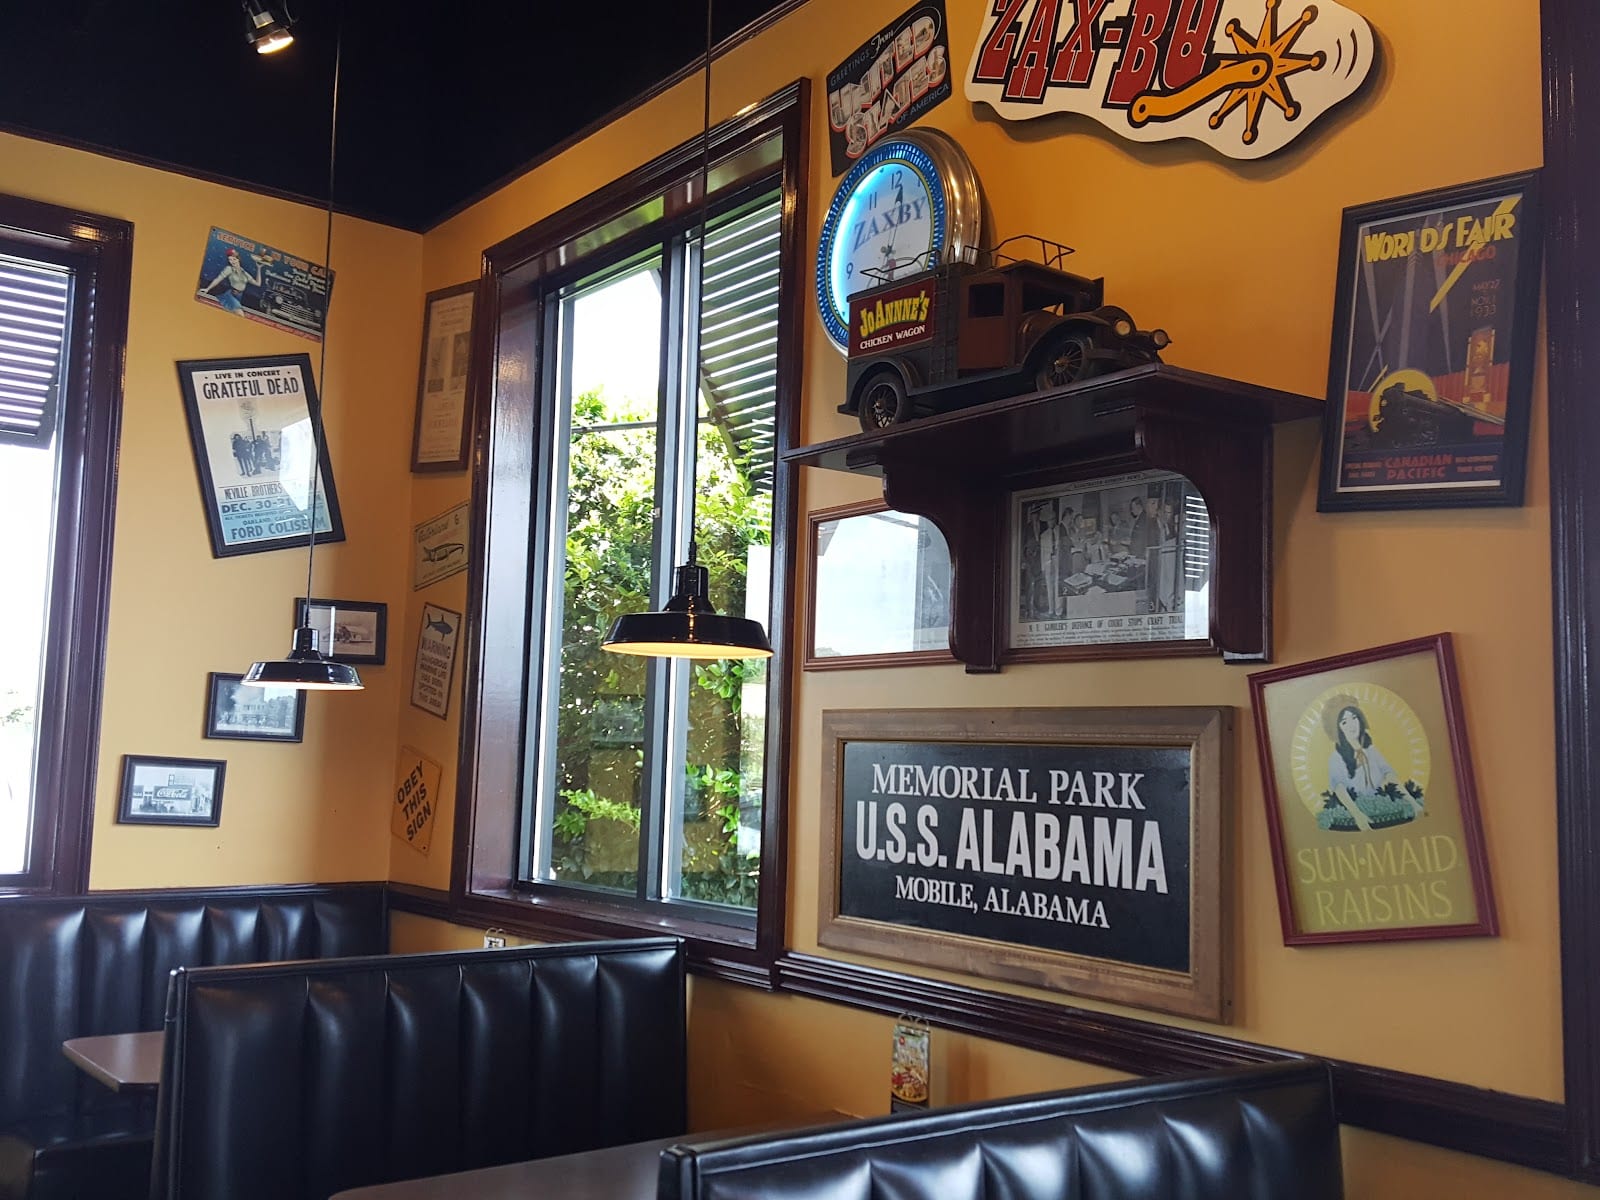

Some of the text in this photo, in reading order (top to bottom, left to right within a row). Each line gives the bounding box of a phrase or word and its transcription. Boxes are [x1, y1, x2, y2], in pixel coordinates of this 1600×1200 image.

[829, 16, 935, 132] UNITED
[830, 49, 870, 86] GREETINGS
[845, 45, 947, 158] STATES
[896, 83, 949, 124] OF AMERICA
[891, 169, 904, 190] 12
[869, 192, 878, 210] 11
[1456, 213, 1516, 248] FAIR
[846, 262, 854, 280] 9
[860, 325, 925, 349] CHICKEN WAGON
[203, 377, 299, 399] GRATEFUL DEAD
[1383, 454, 1453, 468] CANADIAN
[1386, 466, 1446, 480] PACIFIC
[221, 502, 251, 513] DEC.
[224, 482, 282, 500] NEVILLE BROTHERS
[231, 525, 263, 540] FORD
[397, 760, 423, 804] OBEY
[871, 763, 1146, 810] MEMORIAL PARK
[402, 783, 427, 820] THIS
[406, 801, 431, 841] SIGN
[856, 800, 1169, 894] U.S.S. ALABAMA
[895, 875, 1110, 929] MOBILE, ALABAMA
[1316, 880, 1453, 926] RAISINS
